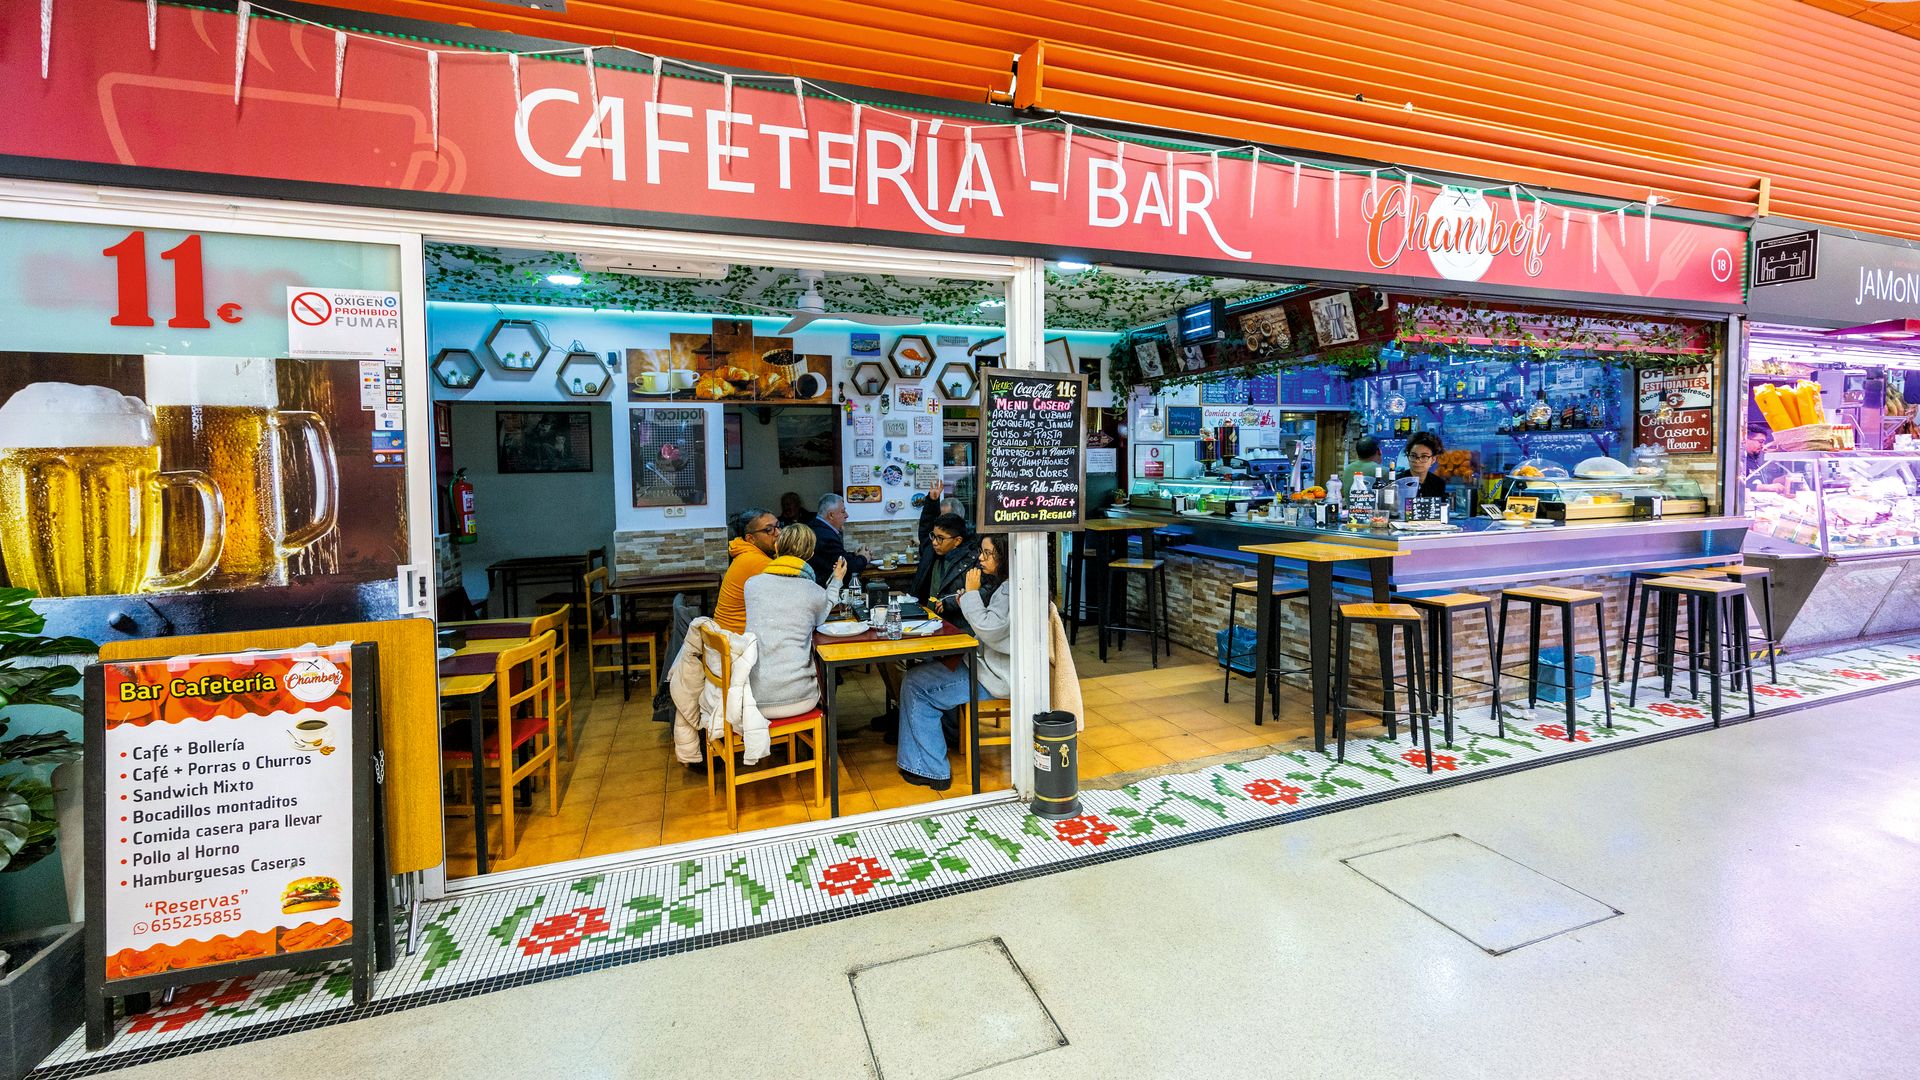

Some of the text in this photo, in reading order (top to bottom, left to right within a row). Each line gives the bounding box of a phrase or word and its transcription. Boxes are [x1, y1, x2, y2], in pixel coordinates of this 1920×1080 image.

[514, 88, 1004, 234] CAFETERÍA
[1088, 157, 1252, 259] BAR
[1716, 258, 1727, 272] 18
[1855, 266, 1919, 305] JAMON
[334, 307, 397, 317] PROHIBIDO
[335, 316, 398, 328] FUMAR
[1641, 364, 1709, 379] OFERTA
[1013, 381, 1054, 399] Coca-Cola
[1057, 381, 1077, 398] 11€
[1644, 377, 1706, 391] ESTUDIANTES
[1677, 387, 1711, 399] Refresco
[996, 397, 1070, 410] MENU CASERO
[992, 409, 1018, 419] ARROZ
[1039, 409, 1072, 419] CUBANA
[1205, 409, 1230, 417] Comidas
[991, 418, 1035, 429] CROQUETAS
[1033, 427, 1063, 439] PASTA
[1654, 426, 1709, 439] Casera
[1667, 438, 1701, 450] llevar
[991, 446, 1034, 457] CHURRASCO
[1003, 496, 1029, 508] CAFÉ
[1036, 495, 1069, 507] POSTRE
[1039, 509, 1072, 520] REGALO
[120, 673, 277, 702] Bar Cafetería
[133, 738, 245, 762] Café + Bollería
[133, 754, 312, 783] Café + Porras o Churros
[133, 779, 254, 802] Sandwich Mixto
[133, 796, 298, 824] Bocadillos montaditos
[133, 814, 323, 845] Comida casera para llevar
[133, 844, 240, 867] Pollo al Horno
[133, 856, 306, 889] Hamburguesas Caseras
[151, 908, 242, 932] 655255855
